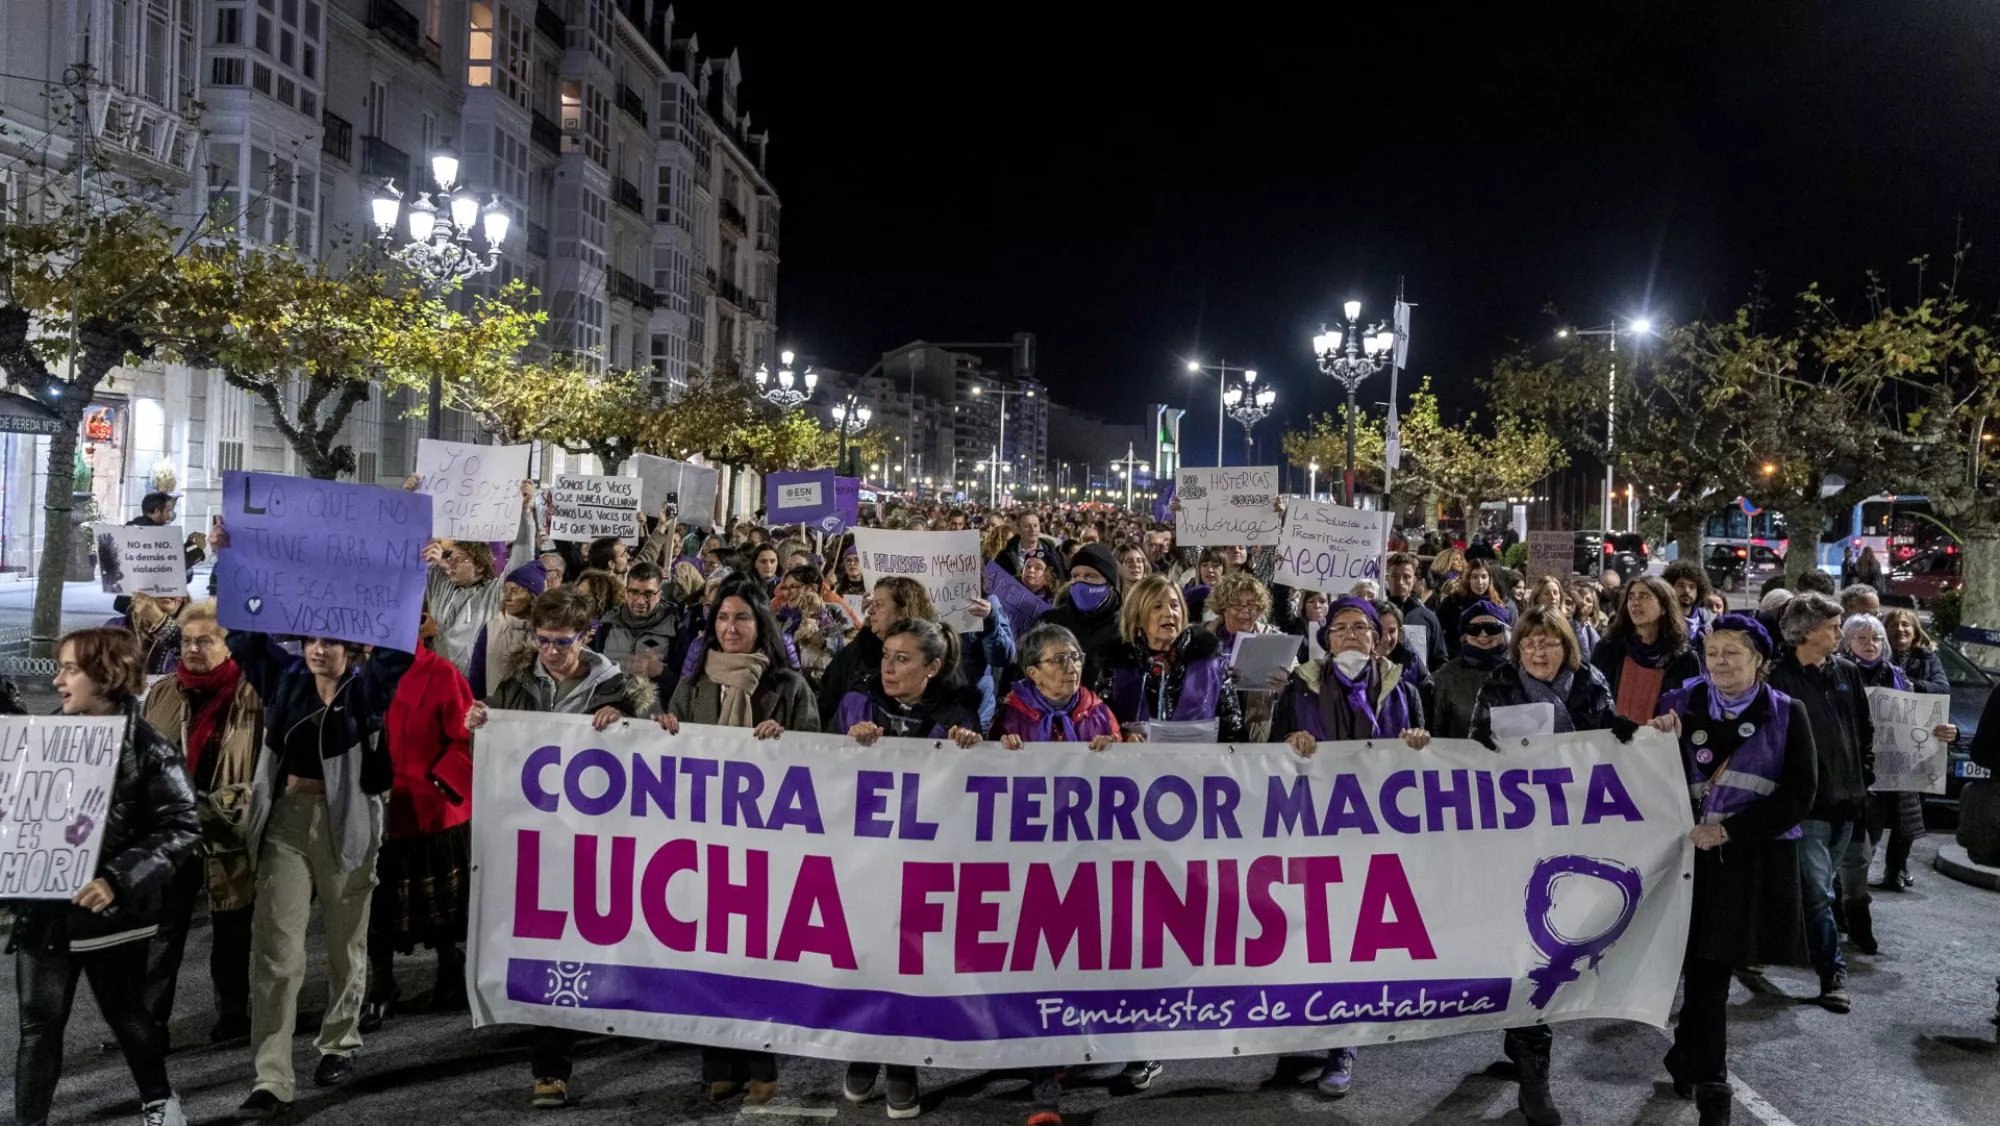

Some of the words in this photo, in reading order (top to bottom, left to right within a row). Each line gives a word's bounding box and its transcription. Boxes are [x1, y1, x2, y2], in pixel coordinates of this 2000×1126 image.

[12, 418, 40, 431] PEREDA
[420, 472, 449, 494] NO
[458, 478, 501, 501] SOY
[503, 480, 521, 499] ES
[587, 480, 602, 493] LAS
[607, 481, 632, 496] VOCES
[1183, 475, 1198, 484] NO
[243, 476, 287, 518] LO
[307, 487, 358, 522] QUE
[378, 499, 408, 525] NO
[554, 492, 573, 502] QUE
[576, 493, 600, 504] NUNCA
[795, 488, 812, 497] ESN
[1230, 494, 1270, 505] SOMOS
[443, 500, 481, 517] QUE
[493, 502, 515, 518] TU
[578, 508, 592, 519] LAS
[597, 510, 619, 521] VOCES
[622, 513, 632, 521] DE
[1293, 506, 1308, 521] LA
[553, 521, 568, 533] LAS
[571, 524, 585, 534] QUE
[589, 524, 598, 534] YA
[601, 525, 611, 534] NO
[127, 541, 140, 549] NO
[246, 526, 308, 563] TUVE
[327, 534, 371, 567] PARA
[136, 553, 165, 561] demás
[874, 552, 927, 573] PALABRAS
[931, 553, 977, 577] MACHISTAS
[132, 565, 172, 573] violación
[233, 566, 284, 597] QUE
[355, 583, 400, 609] PARA
[929, 580, 979, 604] VIOLETAS
[279, 601, 390, 639] VOSOTRAS
[1, 725, 29, 763] LA
[41, 725, 114, 767] VIOLENCIA
[521, 746, 825, 834] CONTRA
[853, 770, 940, 840] EL
[965, 774, 1243, 842] TERROR
[1262, 763, 1644, 837] MACHISTA
[17, 822, 42, 849] ES
[0, 848, 89, 894] MOR!
[512, 829, 858, 970] LUCHA
[898, 853, 1438, 975] FEMINISTA
[1036, 988, 1235, 1030] Feministas
[1248, 990, 1291, 1021] de
[1304, 984, 1496, 1022] Cantabria
